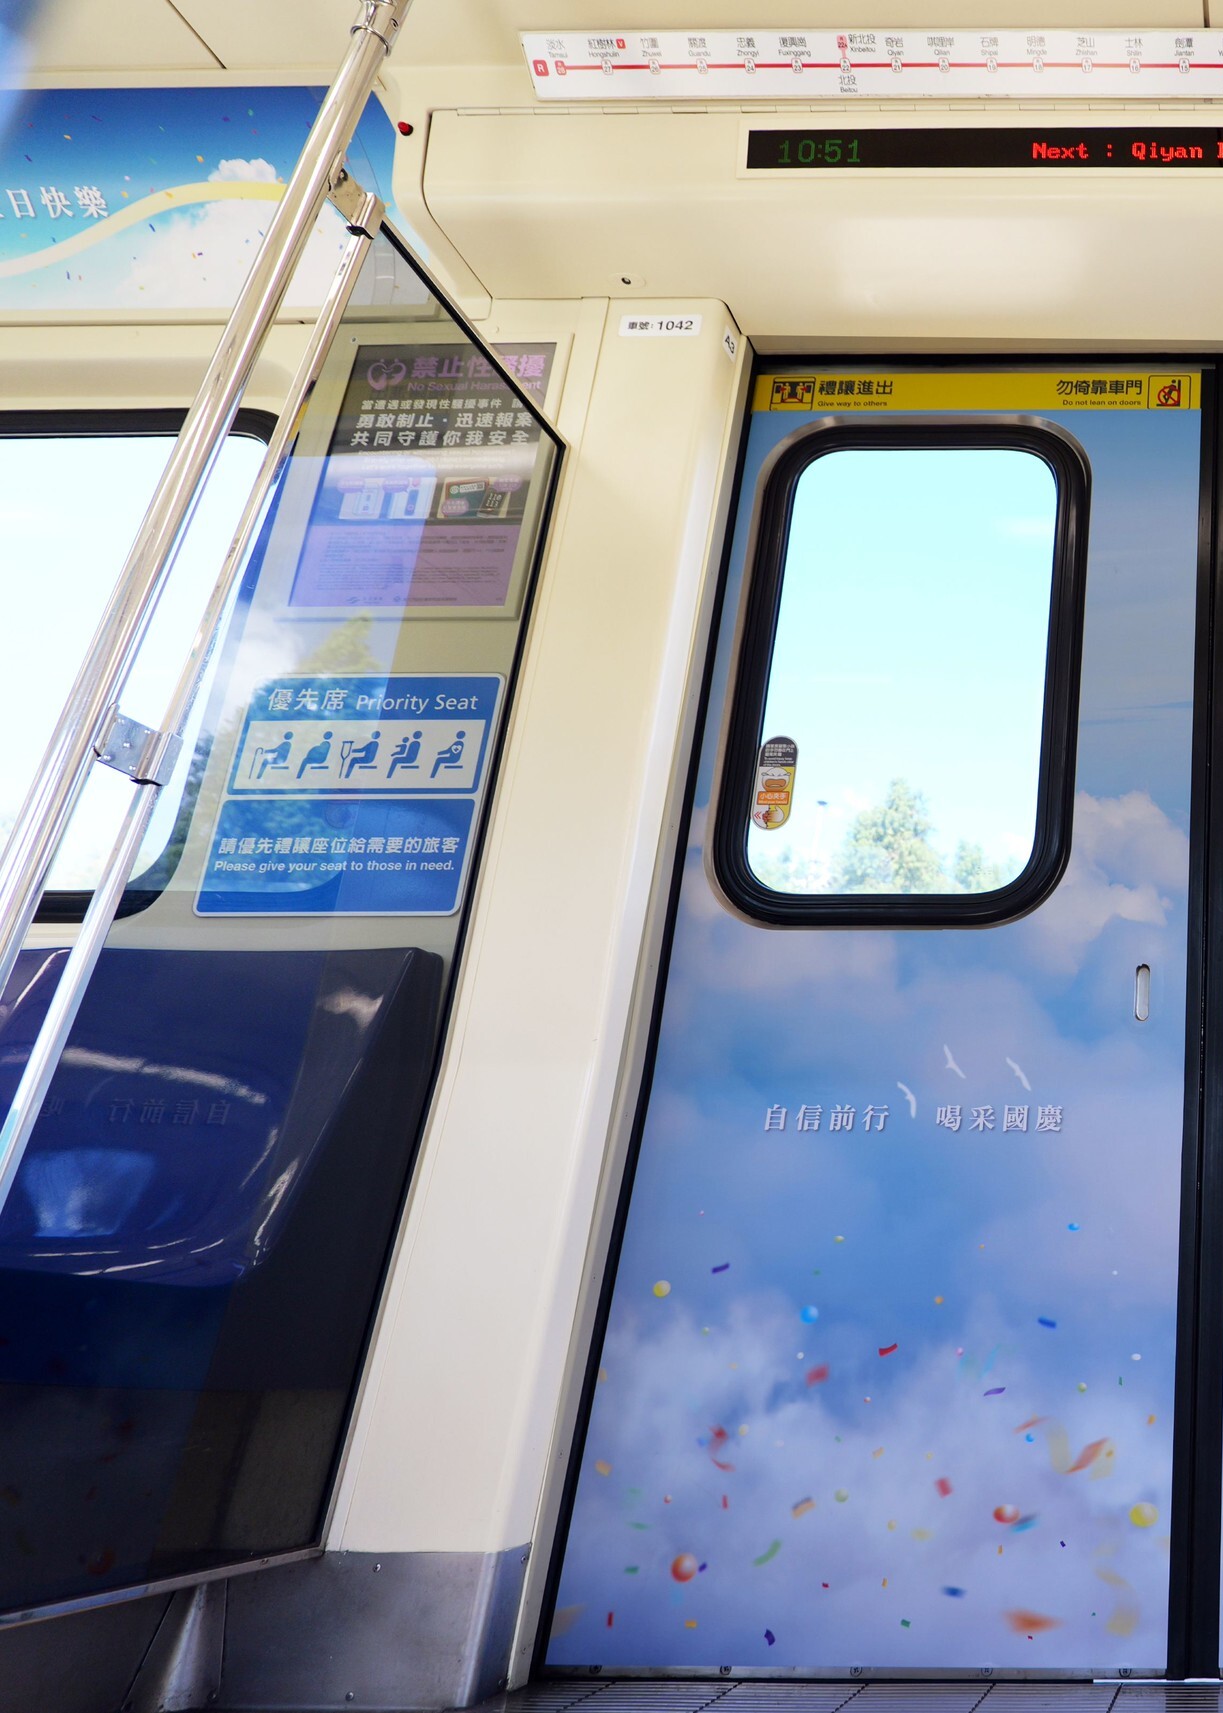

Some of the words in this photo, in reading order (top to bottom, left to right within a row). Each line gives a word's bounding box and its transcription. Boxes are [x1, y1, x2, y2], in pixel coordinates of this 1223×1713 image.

[850, 34, 877, 45] 新北投
[1125, 38, 1143, 48] 士林
[838, 75, 857, 85] 北投
[778, 139, 860, 163] 10:51
[1032, 142, 1088, 159] Next
[1132, 142, 1203, 161] Qiyan
[0, 186, 108, 218] 日快樂
[657, 321, 693, 330] 1042
[407, 382, 424, 391] No
[427, 381, 468, 391] Sexual
[818, 380, 893, 395] 禮讓進出
[1056, 380, 1142, 395] 勿倚靠車門
[356, 414, 434, 428] 勇敢制止
[455, 413, 533, 428] 迅速報案
[350, 431, 529, 446] 共同守護你我安全
[268, 688, 348, 711] 優先席
[356, 695, 429, 714] Priority
[434, 694, 478, 710] Seat
[218, 837, 459, 855] 請優先禮讓座位給需要的旅客
[214, 861, 255, 871] Please
[259, 861, 285, 872] give
[288, 862, 317, 872] your
[321, 861, 347, 871] seat
[351, 861, 363, 871] to
[367, 860, 402, 871] those
[405, 860, 417, 870] in
[420, 860, 454, 871] need.
[764, 1104, 890, 1132] 自信前行
[936, 1104, 1064, 1133] 喝采國慶
